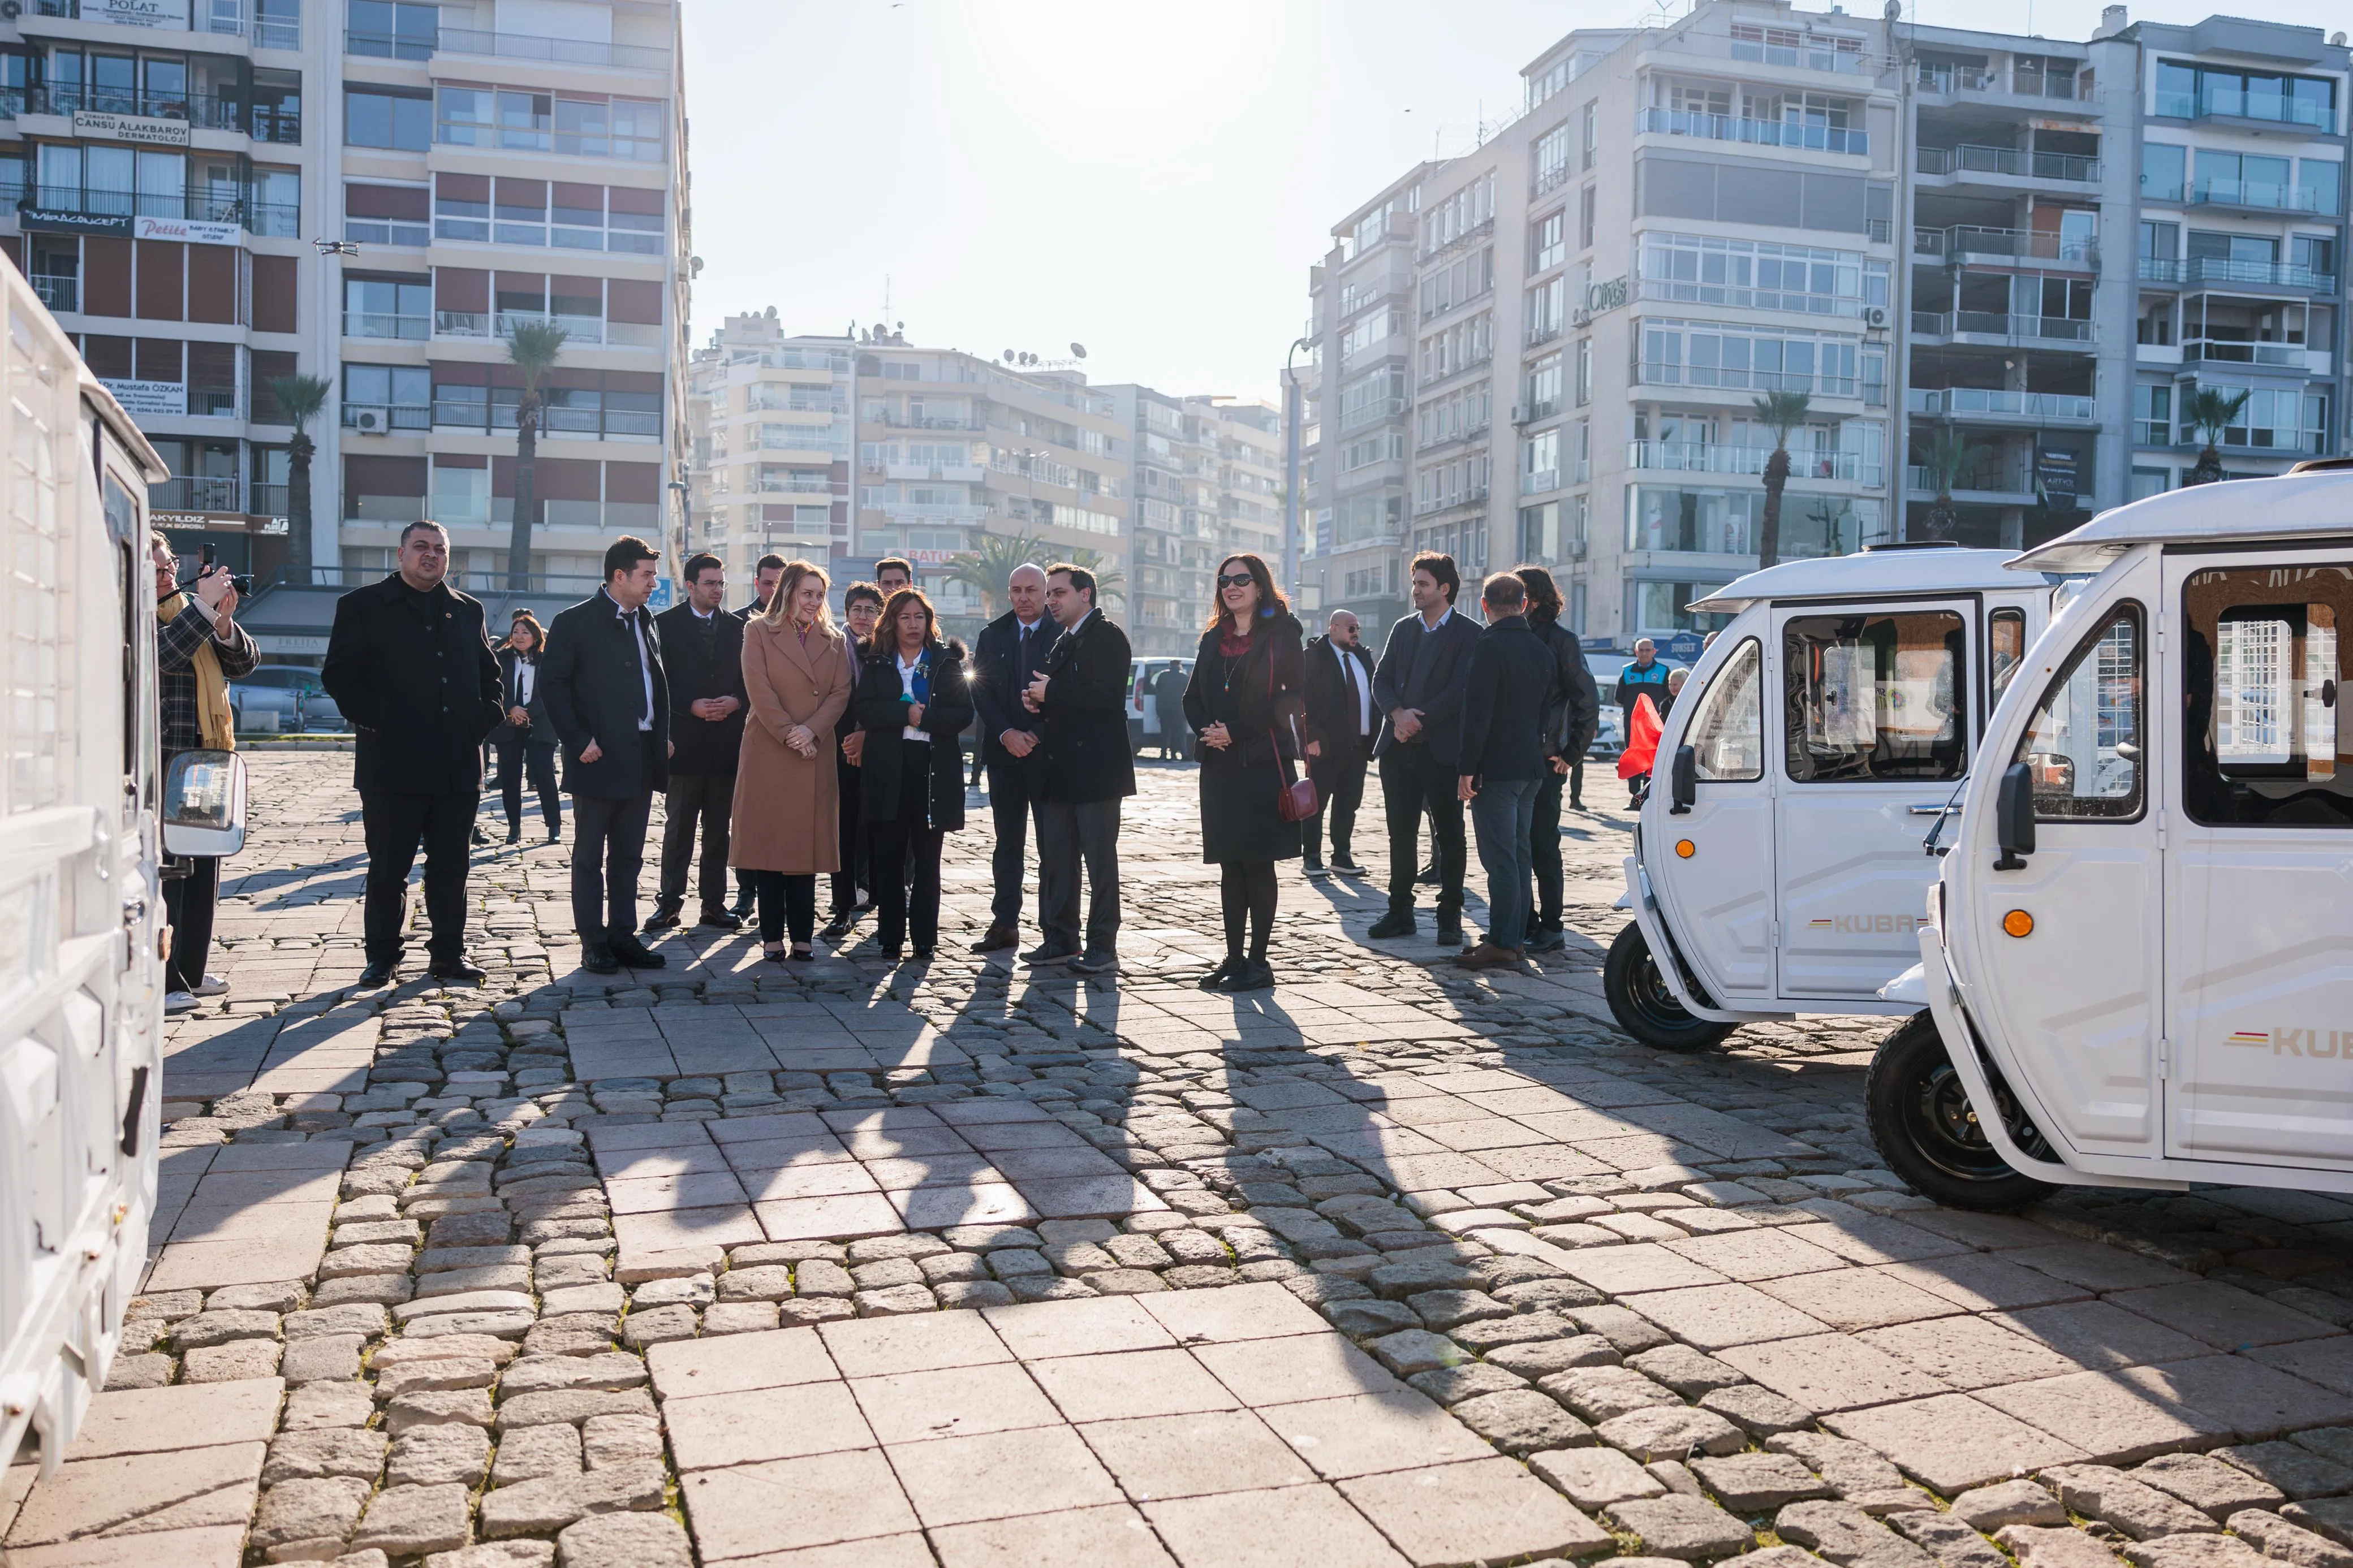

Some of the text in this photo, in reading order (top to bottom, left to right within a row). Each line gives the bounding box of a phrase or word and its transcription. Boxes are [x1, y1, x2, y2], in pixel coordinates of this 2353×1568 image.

[109, 0, 159, 12] POLAT
[76, 117, 187, 135] CANSU ALAKBAROV
[141, 219, 187, 236] Petite
[117, 383, 150, 392] Mustafa
[152, 383, 183, 393] ÖZKAN
[149, 514, 205, 523] AKYILDIZ
[1671, 643, 1696, 653] SUNSET
[1835, 914, 1914, 933] KUBA
